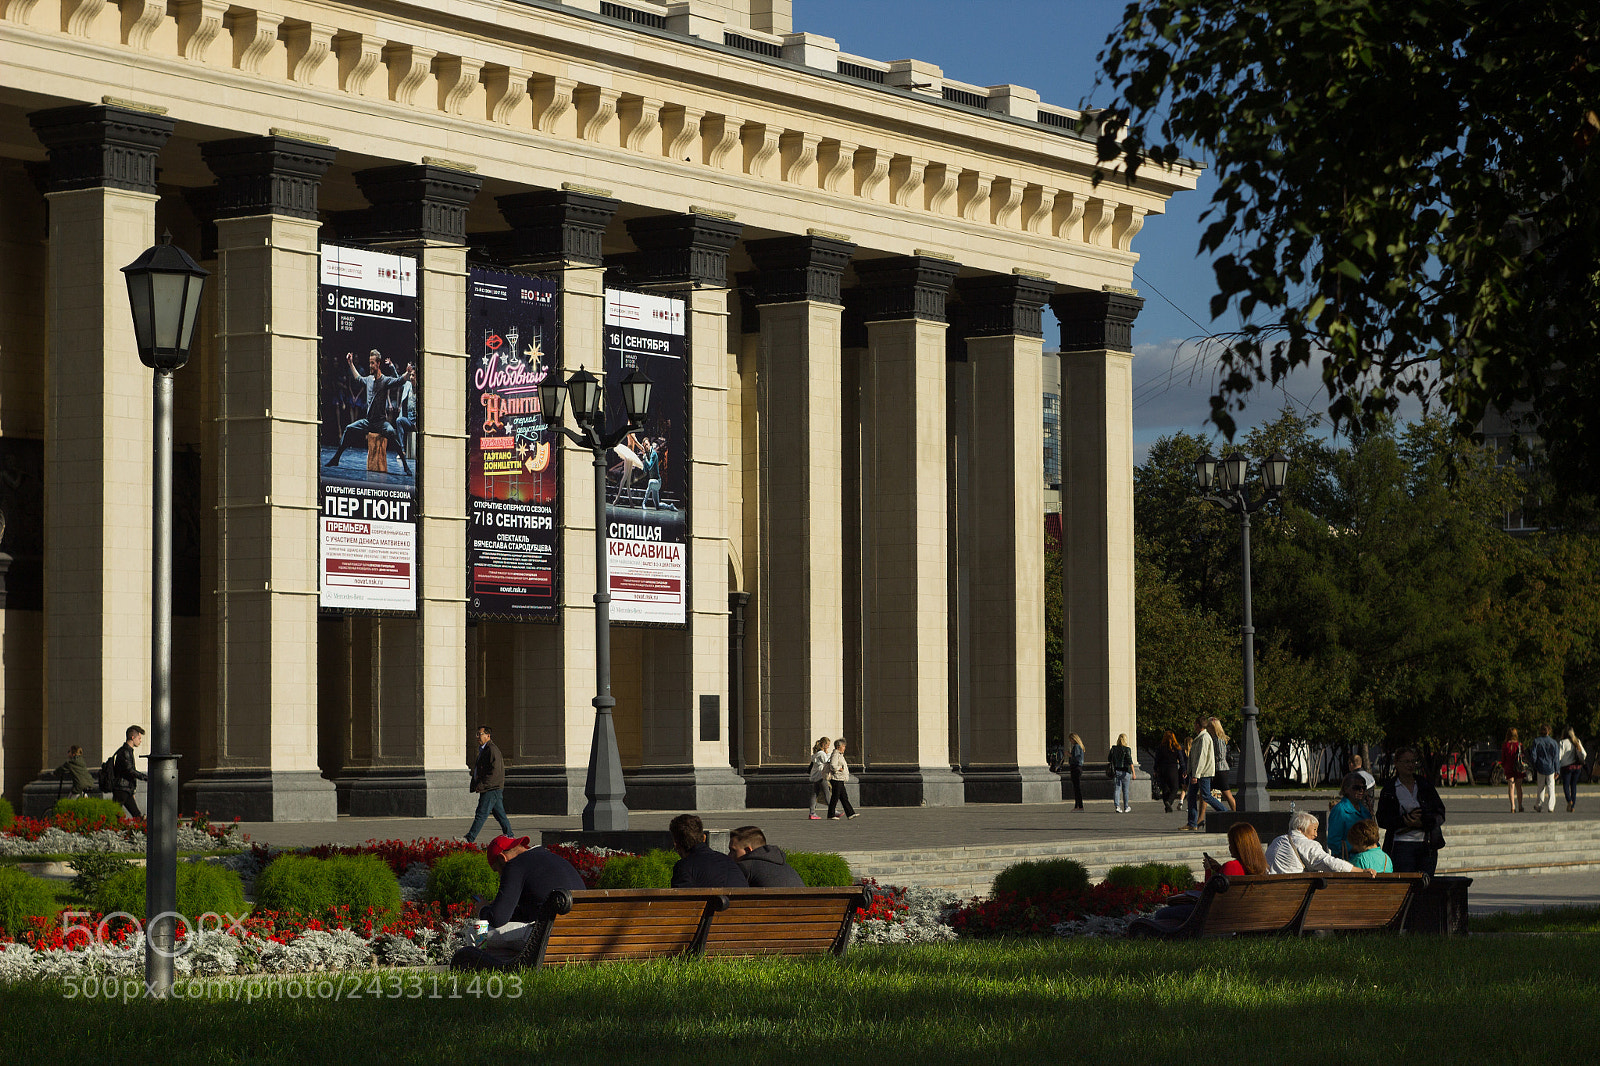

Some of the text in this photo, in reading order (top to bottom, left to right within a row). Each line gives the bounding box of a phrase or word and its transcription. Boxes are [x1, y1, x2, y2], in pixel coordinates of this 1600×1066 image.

[327, 293, 394, 314] 9 СЕНТЯБРЯ
[610, 333, 670, 352] 16 СЕНТЯБРЯ
[475, 352, 549, 390] Любовный
[484, 452, 512, 460] ГАЭТАНО
[484, 461, 522, 470] ДОНИЦЕТТИ
[325, 486, 411, 499] ОТКРЫТИЕ БАЛЕТНОГО СЕЗОНА
[325, 496, 411, 521] ПЕР ГЮНТ
[473, 501, 552, 514] ОТКРЫТИЕ ОПЕРНОГО СЕЗОНА
[327, 522, 369, 534] ПРЕМЬЕРА
[495, 513, 552, 530] СЕНТЯБРЯ
[497, 534, 530, 542] СПЕКТАКЛЬ
[609, 522, 662, 542] СПЯЩАЯ
[330, 536, 358, 544] УЧАСТИЕМ
[358, 538, 379, 546] ДЕНИСА
[380, 540, 411, 548] МАТВИЕНКО
[473, 540, 552, 552] ВЯЧЕСЛАВА СТАРОДУБЦЕВА
[609, 541, 681, 563] КРАСАВИЦА
